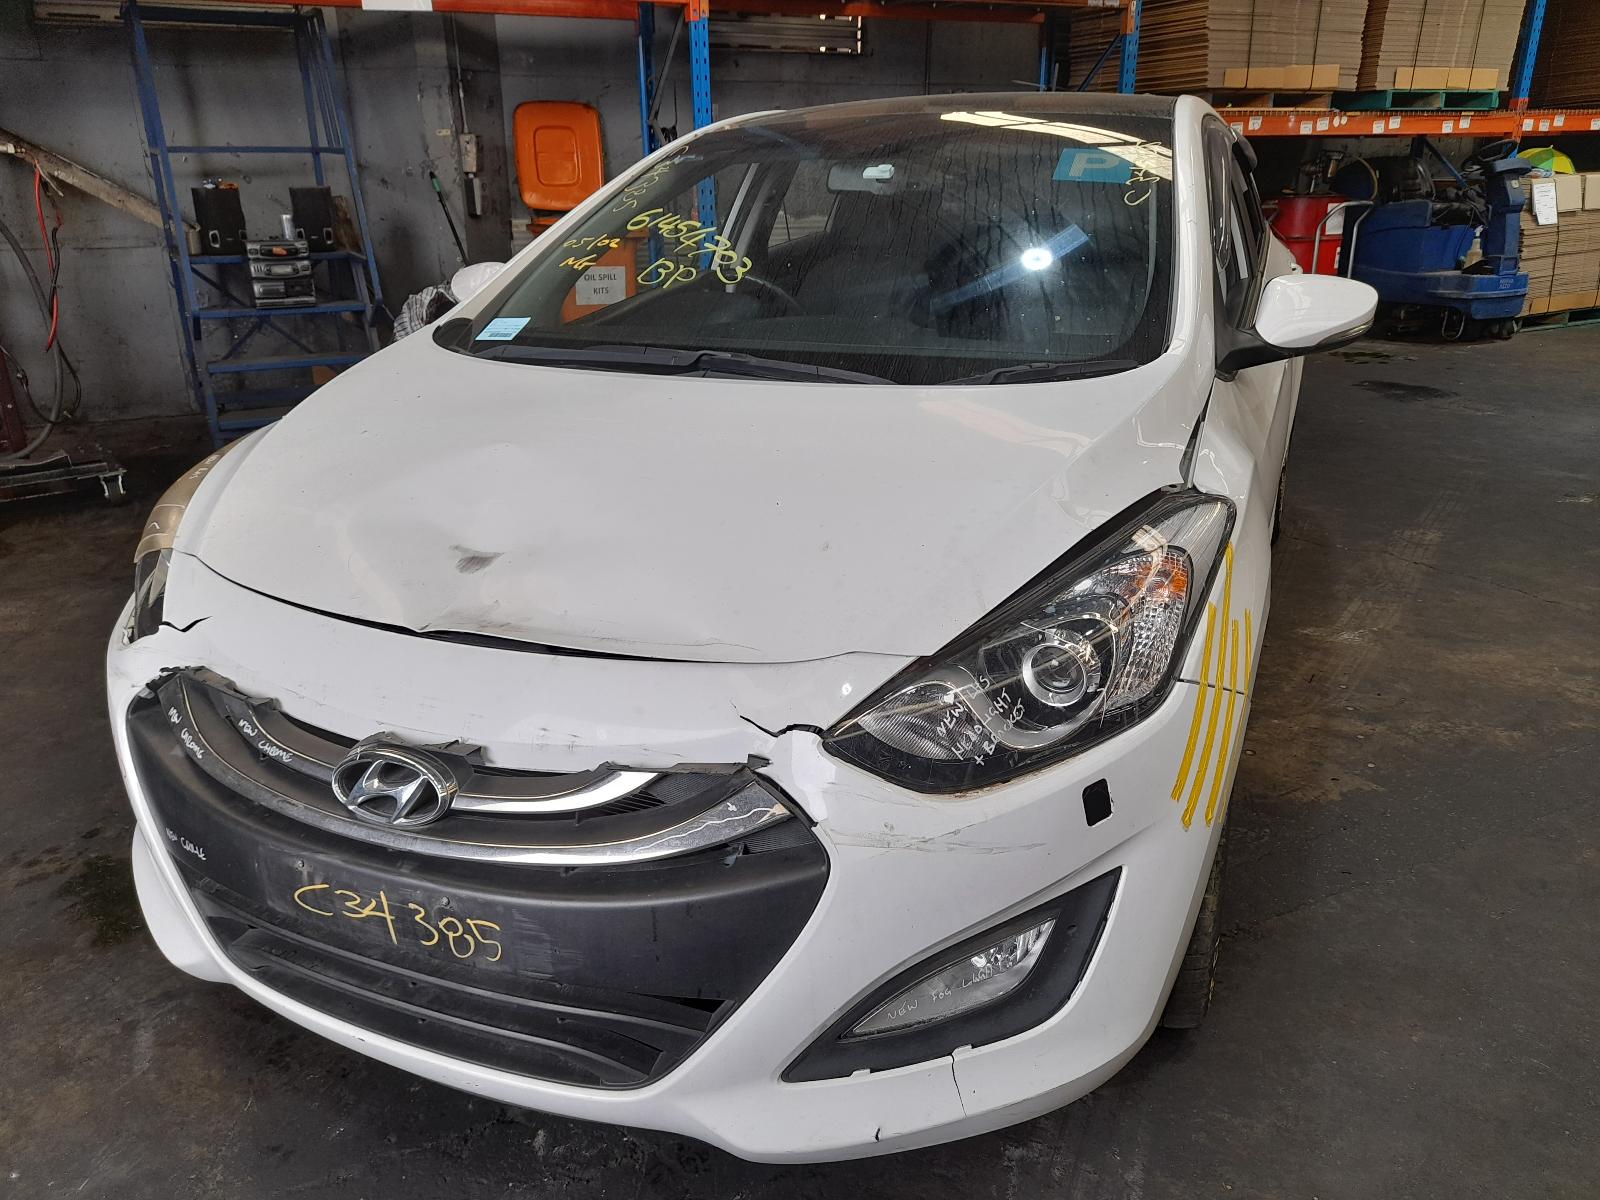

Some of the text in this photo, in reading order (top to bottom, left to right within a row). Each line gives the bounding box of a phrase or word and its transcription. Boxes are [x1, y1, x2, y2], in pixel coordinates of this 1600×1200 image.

[1068, 152, 1121, 177] P
[583, 273, 617, 281] OIL SPILL
[593, 287, 609, 295] KITS
[238, 718, 258, 737] NEW
[937, 701, 966, 737] NEW
[887, 1000, 918, 1020] NEW
[930, 988, 952, 1003] FOG
